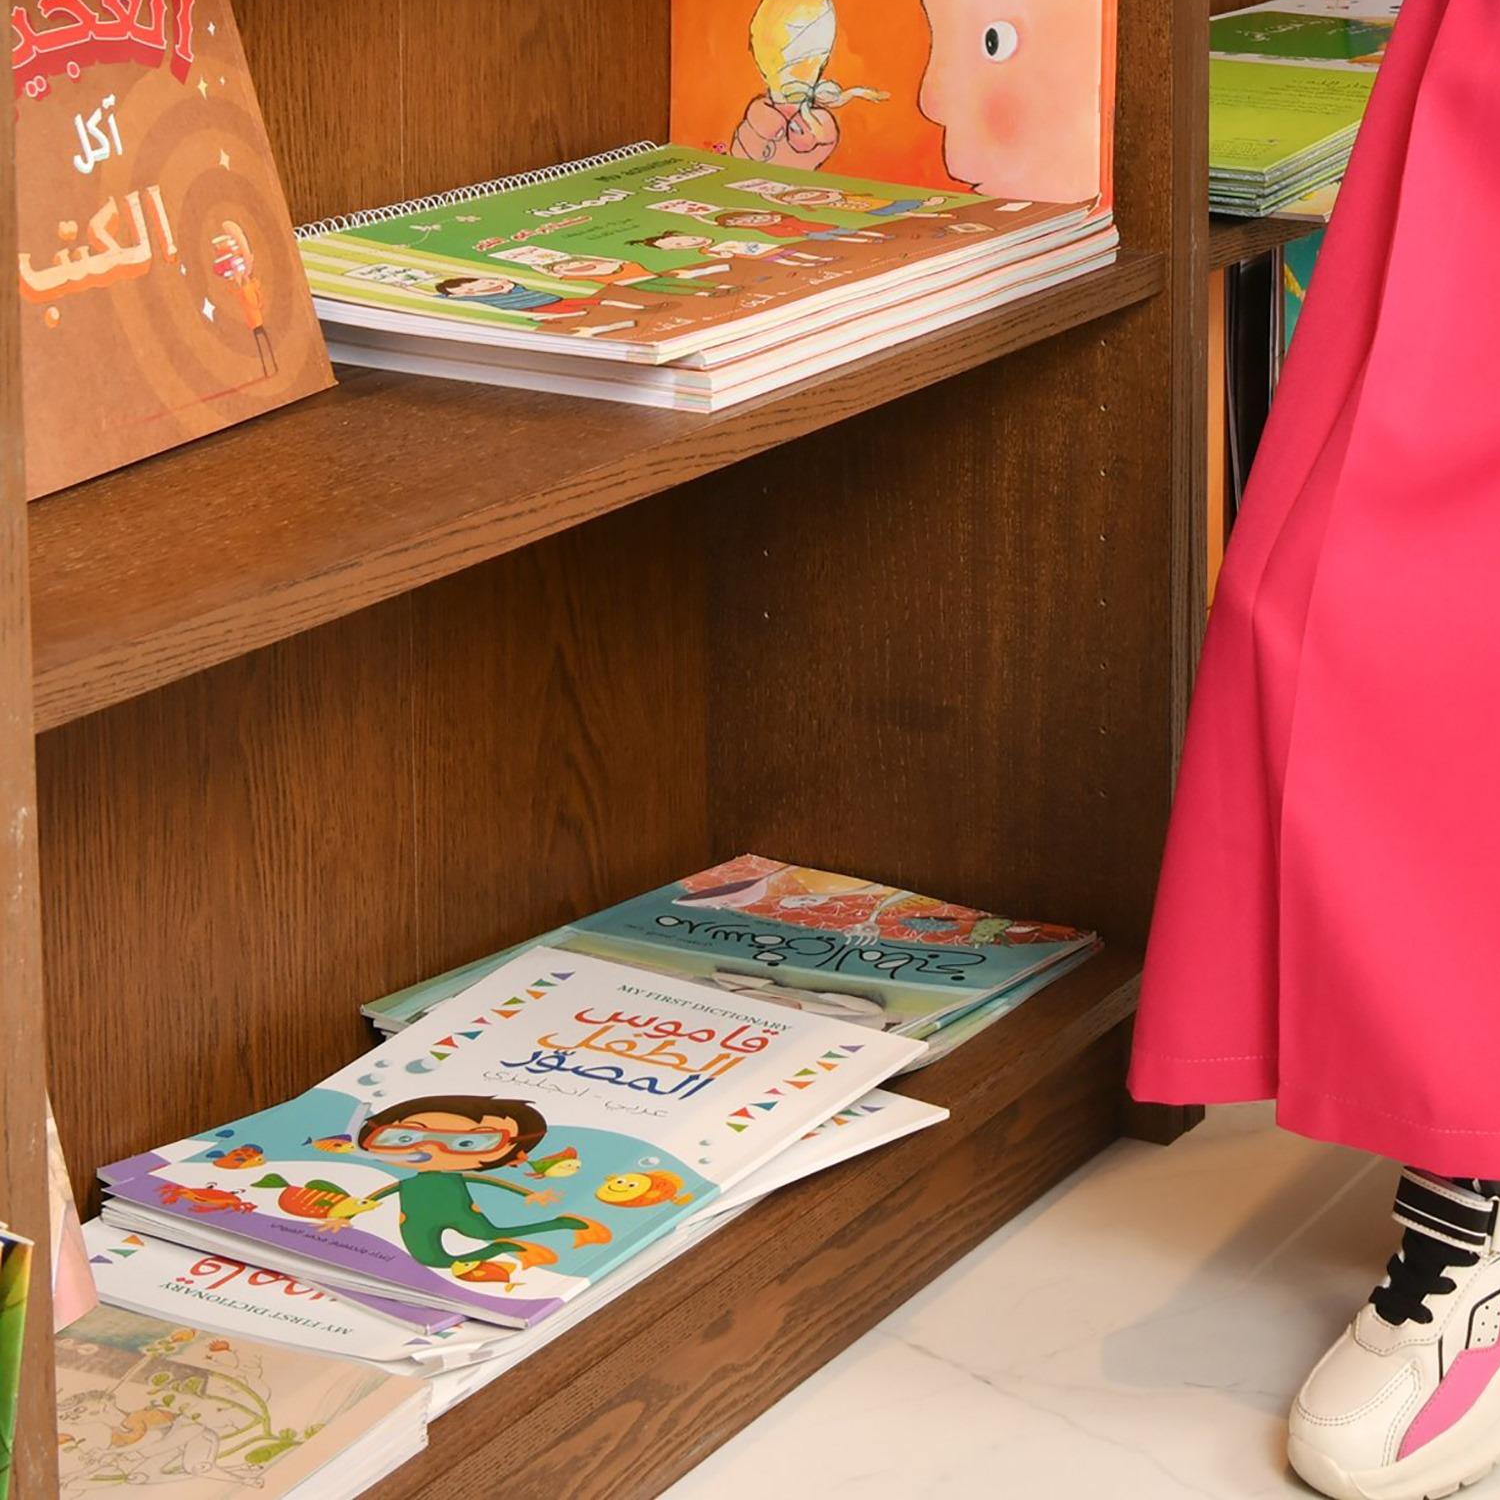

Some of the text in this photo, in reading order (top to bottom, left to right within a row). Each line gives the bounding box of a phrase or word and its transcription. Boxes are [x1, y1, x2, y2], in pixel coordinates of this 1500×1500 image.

[18, 185, 178, 328] الكتب
[574, 1007, 780, 1053] قاموس
[616, 983, 793, 1032] MY FIRST DICTIONARY
[537, 1025, 747, 1079] الطفل
[604, 1098, 670, 1118] عربي
[158, 1281, 354, 1336] MY FIRST DICTIONARY
